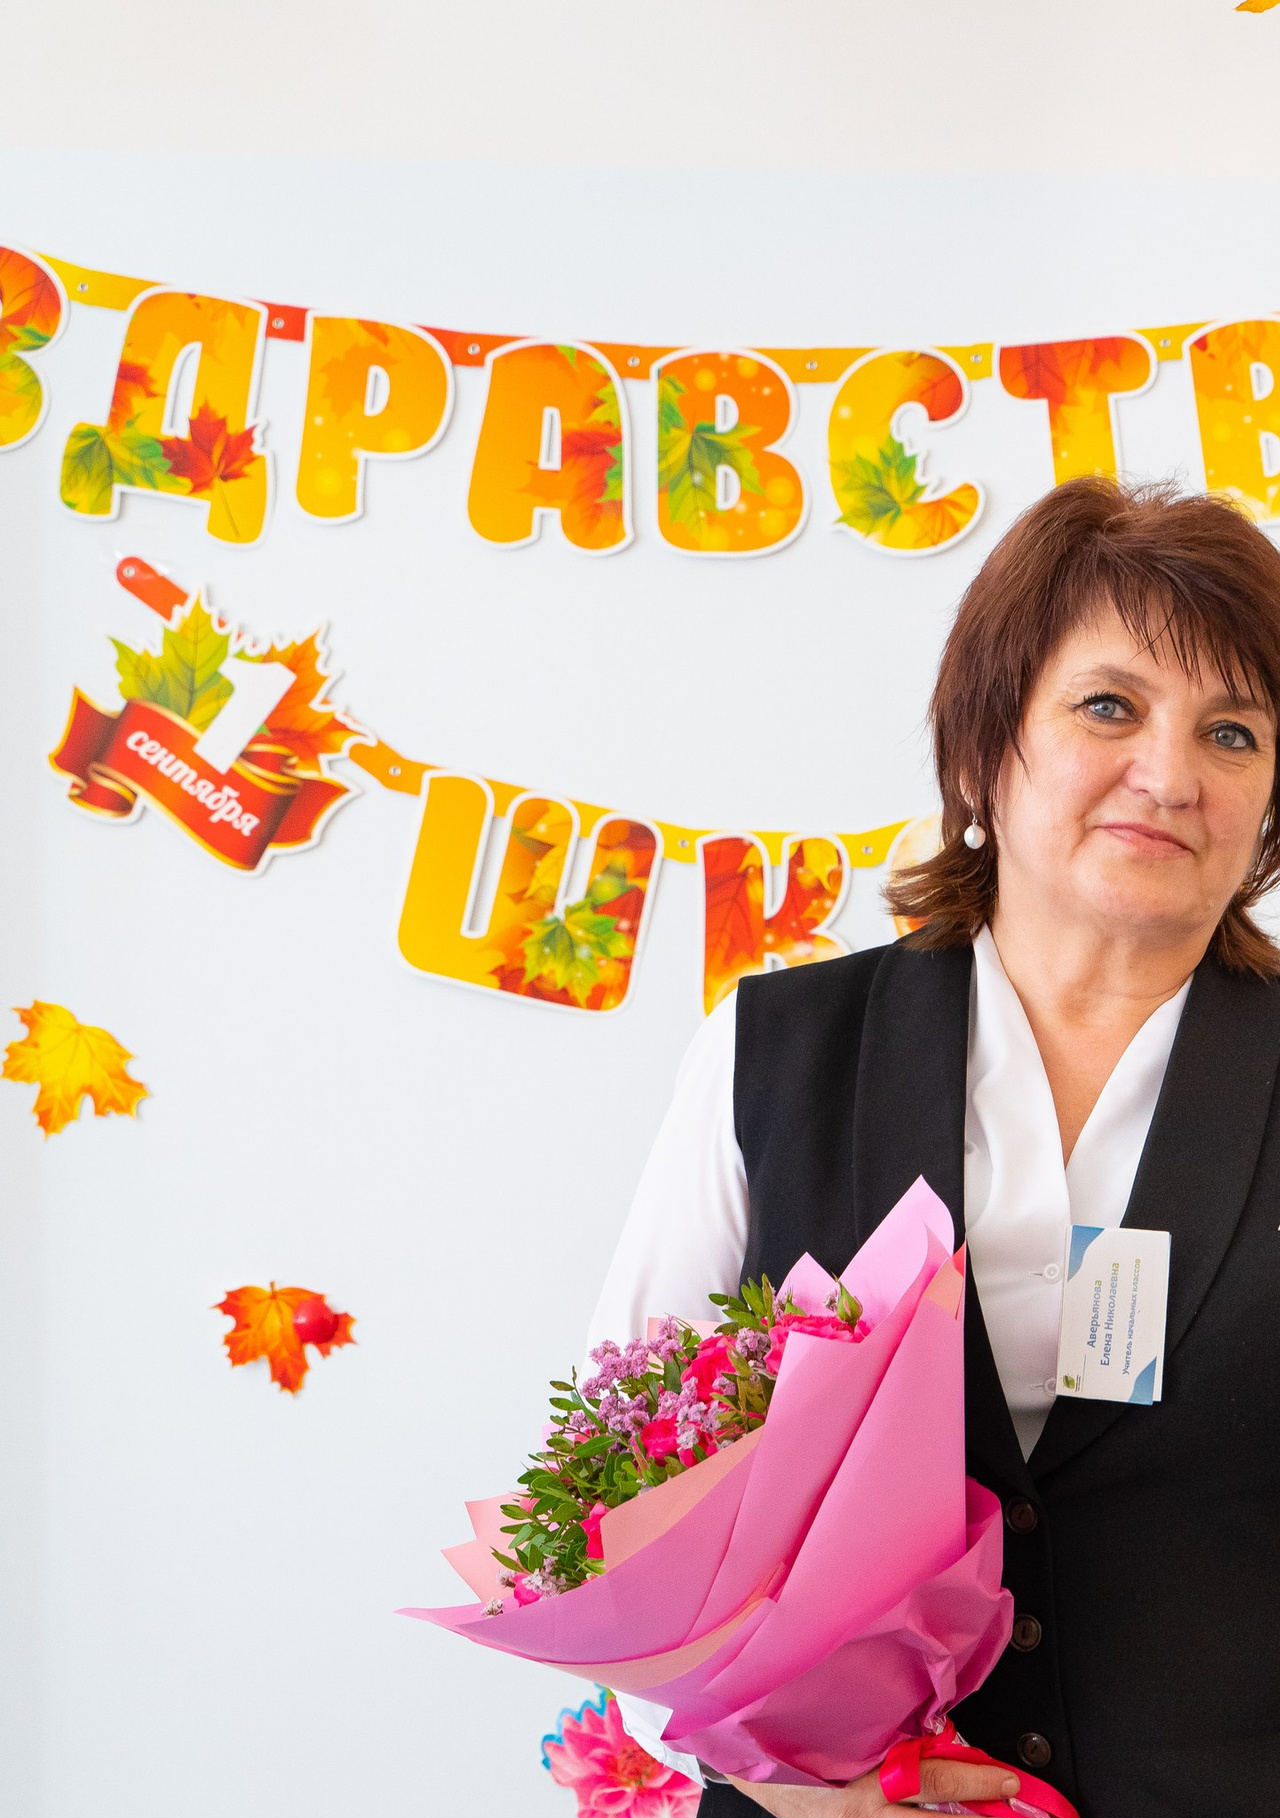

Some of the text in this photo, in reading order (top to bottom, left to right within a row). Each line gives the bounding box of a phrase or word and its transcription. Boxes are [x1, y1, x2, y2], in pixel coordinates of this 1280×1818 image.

[192, 655, 298, 775] 1
[125, 730, 261, 837] сентября
[1087, 1279, 1102, 1348] Аверьянова
[1101, 1262, 1120, 1366] Елена Николаевна
[1122, 1258, 1141, 1375] Учитель начальных классов
